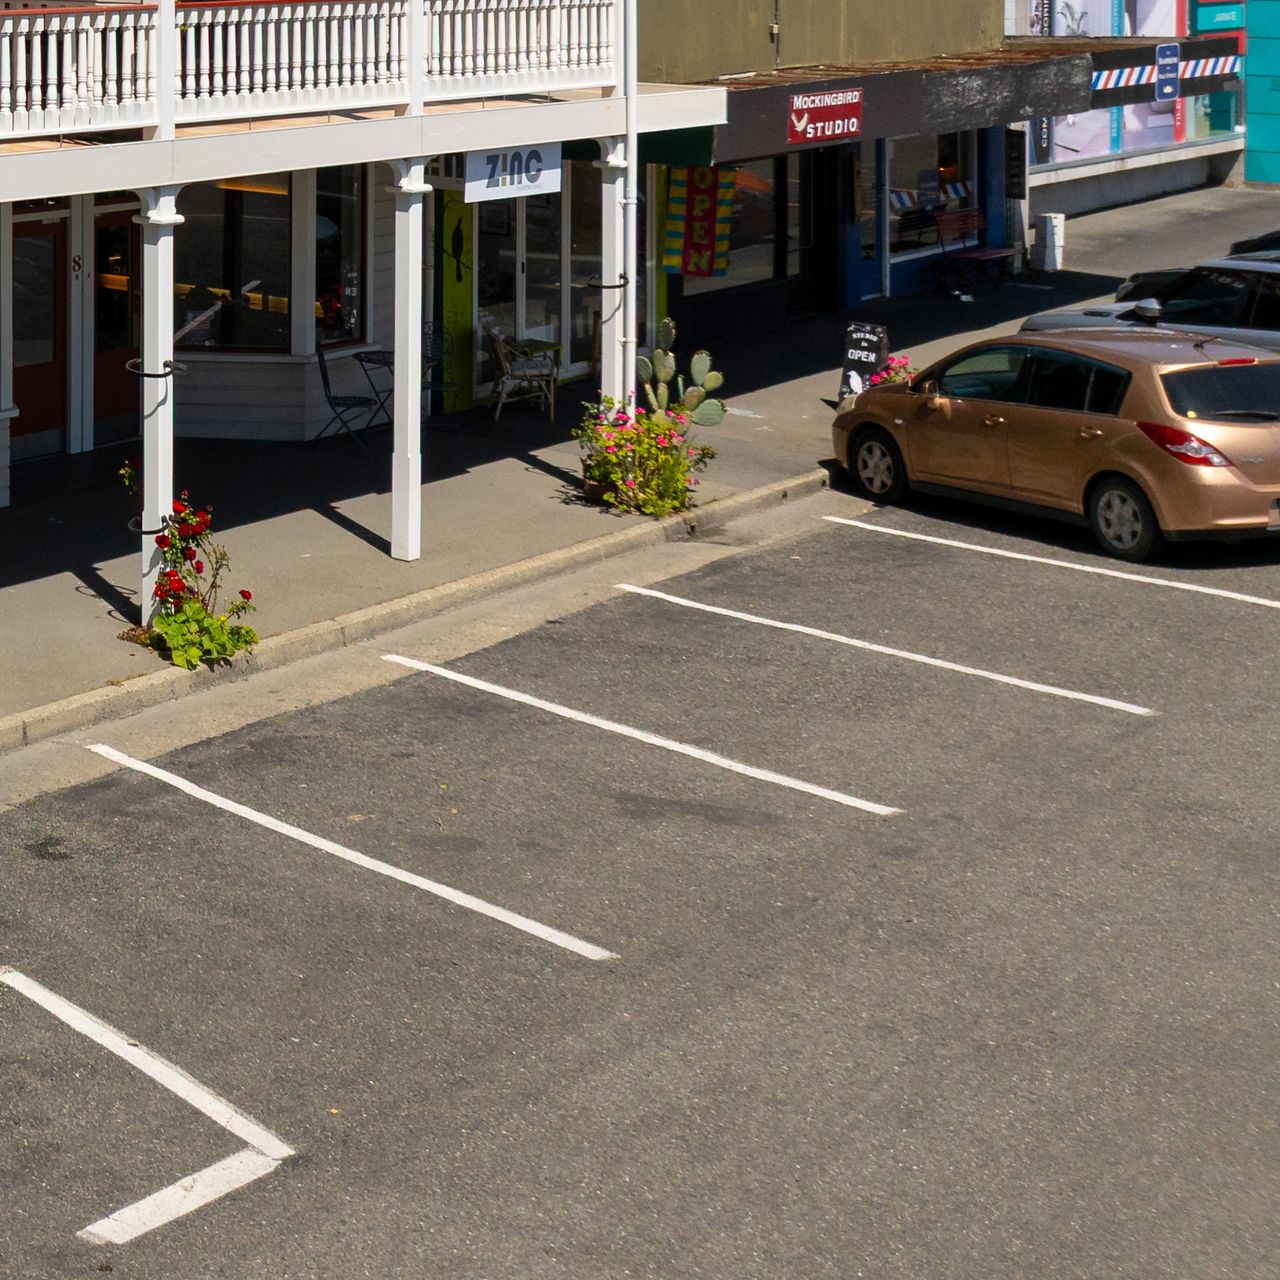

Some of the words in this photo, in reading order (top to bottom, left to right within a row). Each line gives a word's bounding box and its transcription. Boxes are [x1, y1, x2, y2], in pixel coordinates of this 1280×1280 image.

[806, 117, 858, 138] STUDIO
[687, 165, 714, 272] OPEN
[72, 255, 81, 272] 8
[848, 349, 877, 363] OPEN
